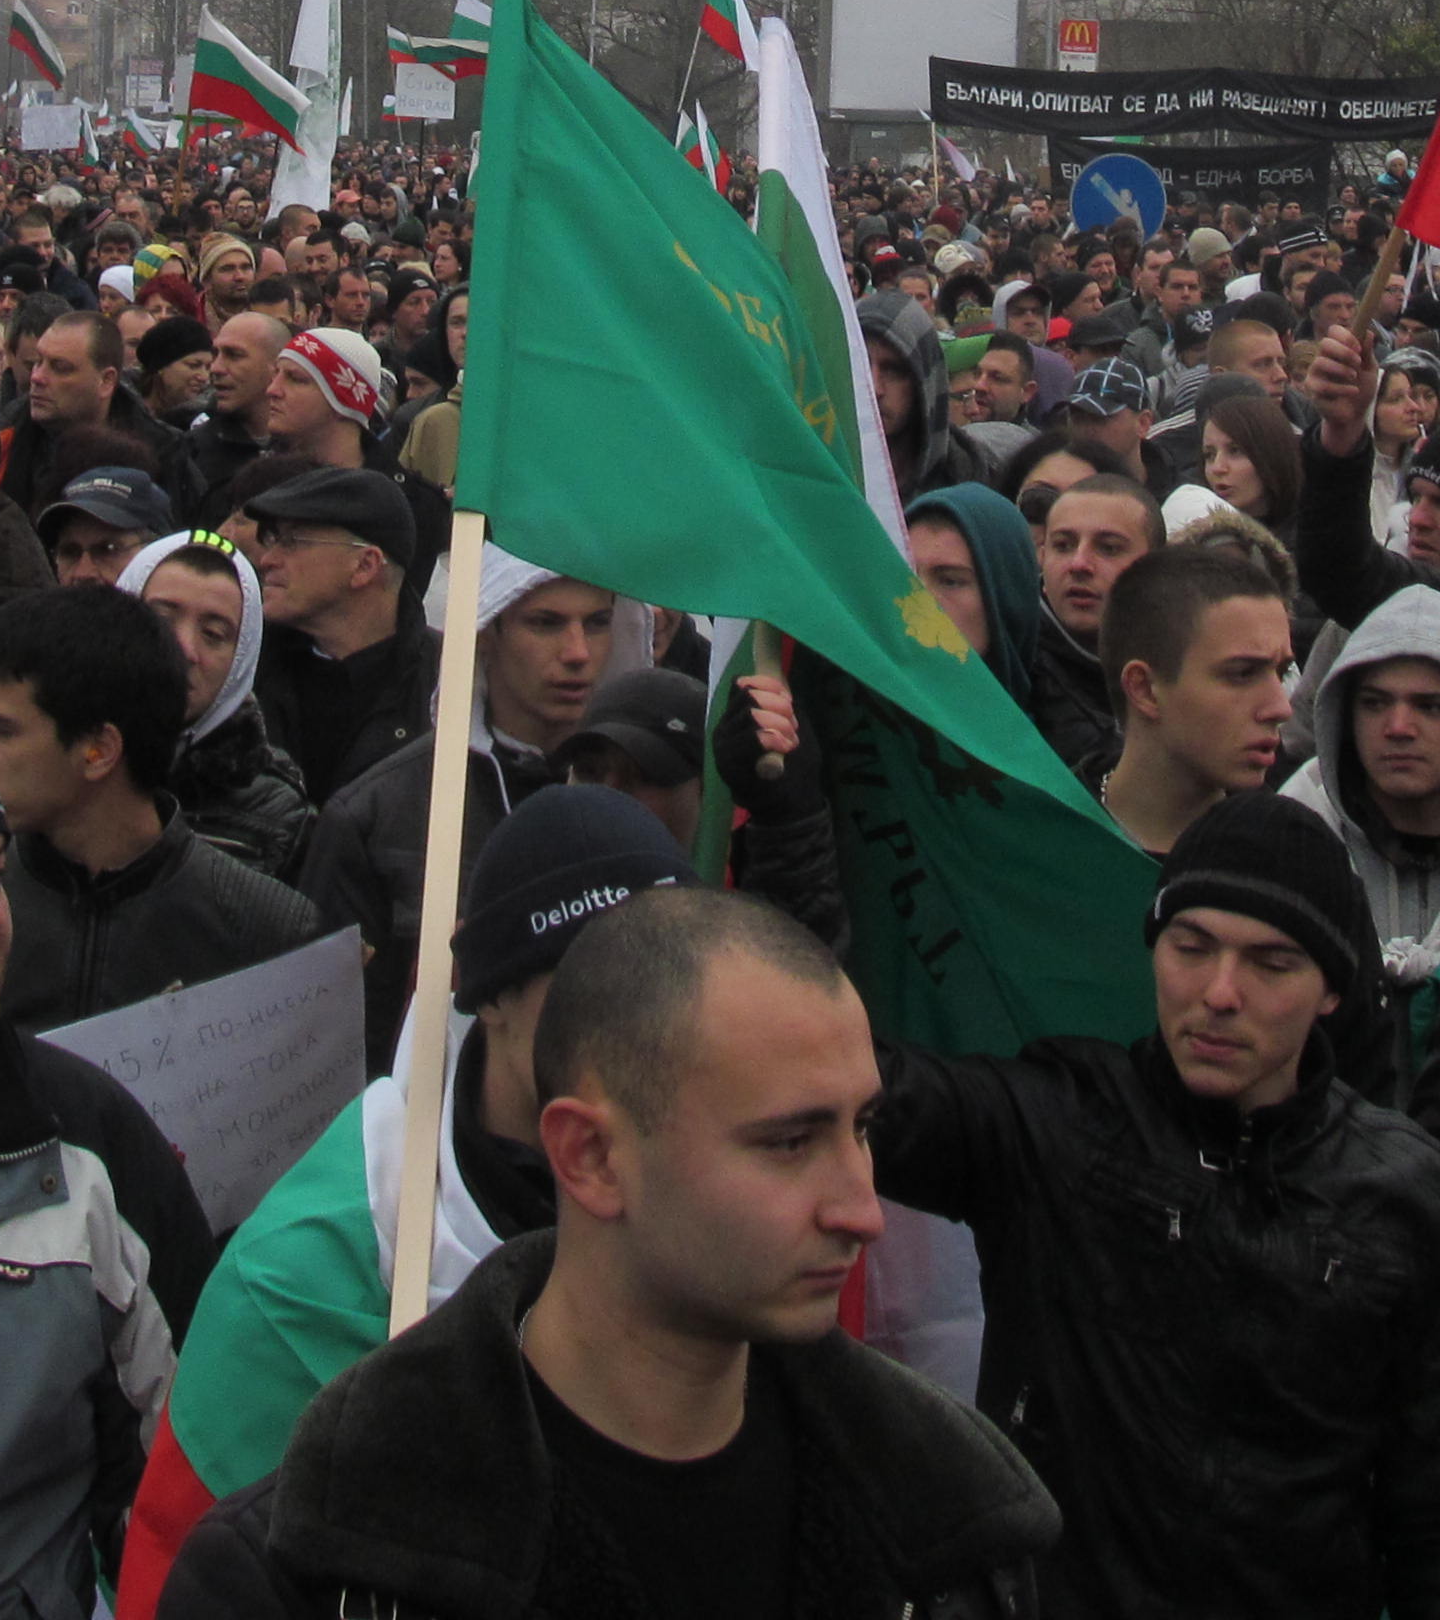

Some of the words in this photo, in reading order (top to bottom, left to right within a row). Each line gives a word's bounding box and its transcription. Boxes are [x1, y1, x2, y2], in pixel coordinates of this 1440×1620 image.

[1032, 91, 1113, 113] ОПИТВАТ
[1122, 94, 1147, 113] СЕ
[1154, 93, 1181, 114] ДА
[1189, 88, 1214, 108] НИ
[1339, 98, 1438, 119] ОБЕДИНЕТЕ
[1195, 169, 1242, 188] ЕДНА
[1258, 167, 1315, 185] БОРБА
[530, 884, 632, 934] Deloitte
[239, 1033, 320, 1080] ТОКА
